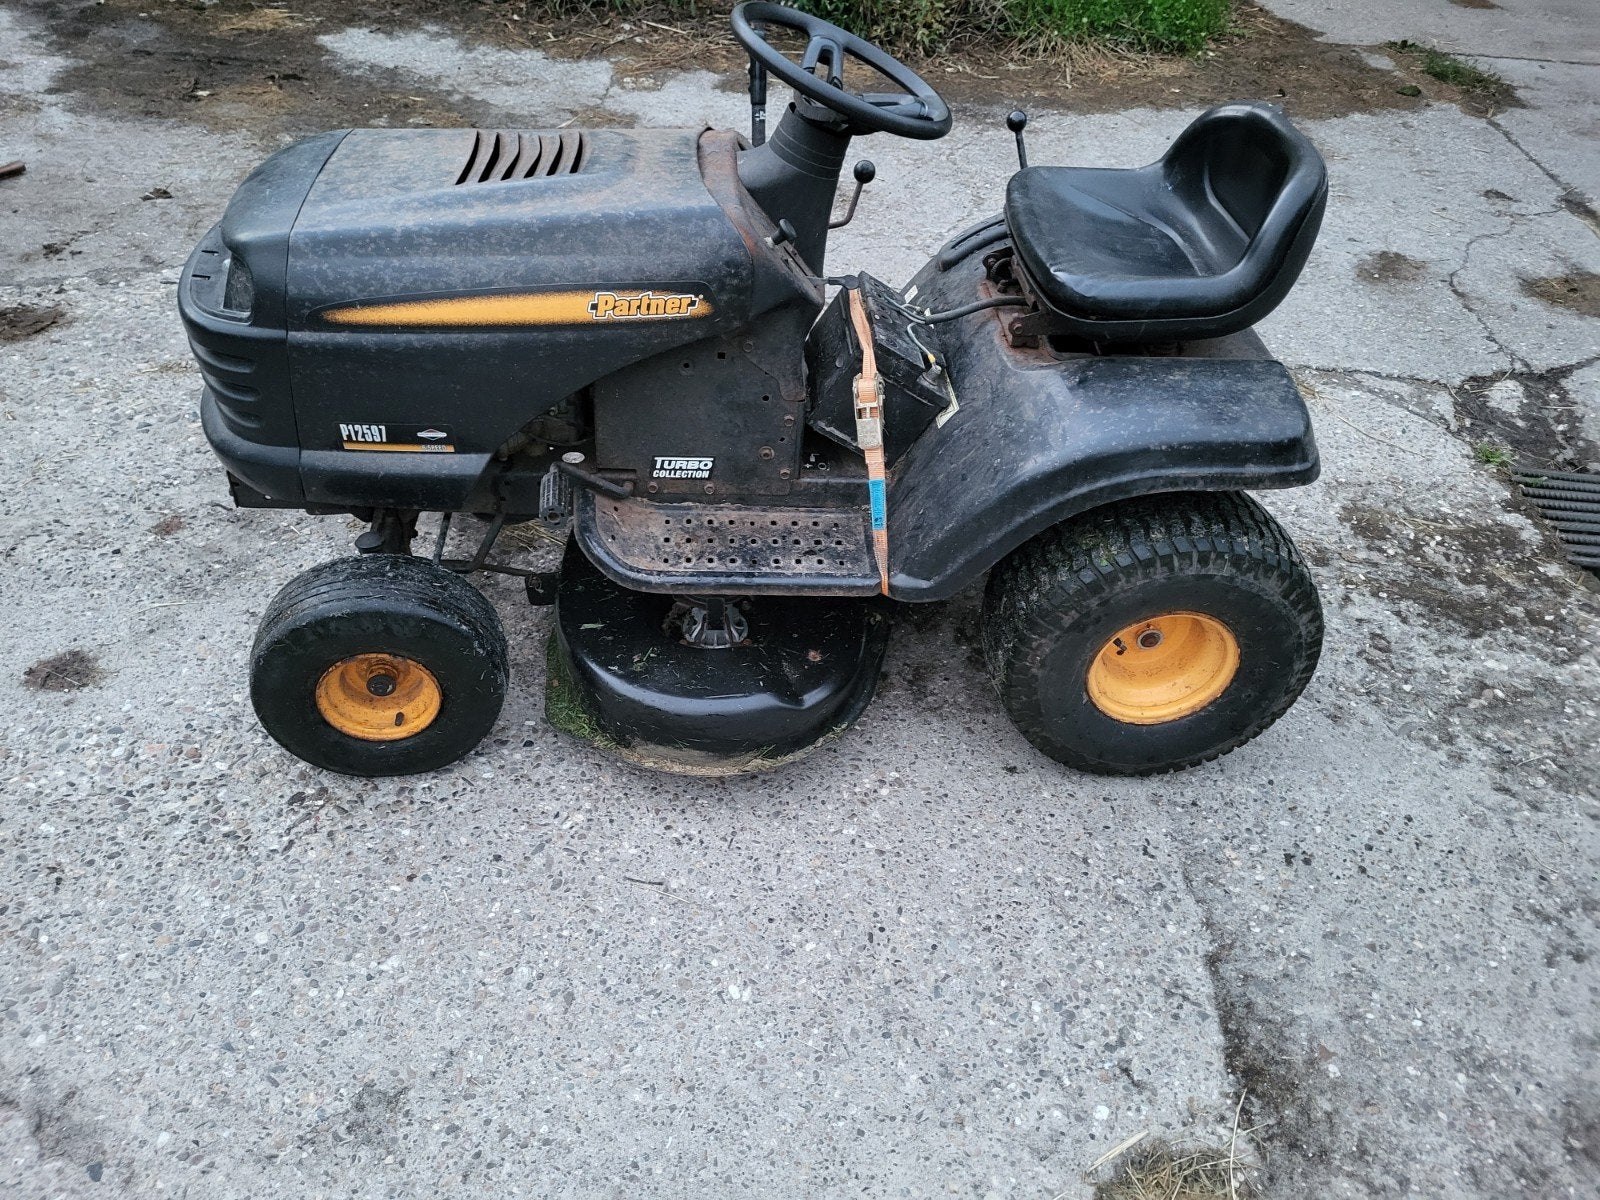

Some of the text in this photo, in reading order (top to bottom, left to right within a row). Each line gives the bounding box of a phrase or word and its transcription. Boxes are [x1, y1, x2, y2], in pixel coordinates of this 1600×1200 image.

[596, 293, 692, 317] Partner
[340, 424, 387, 442] P12597
[654, 456, 714, 470] TURBO
[652, 469, 710, 479] COLLECTION
